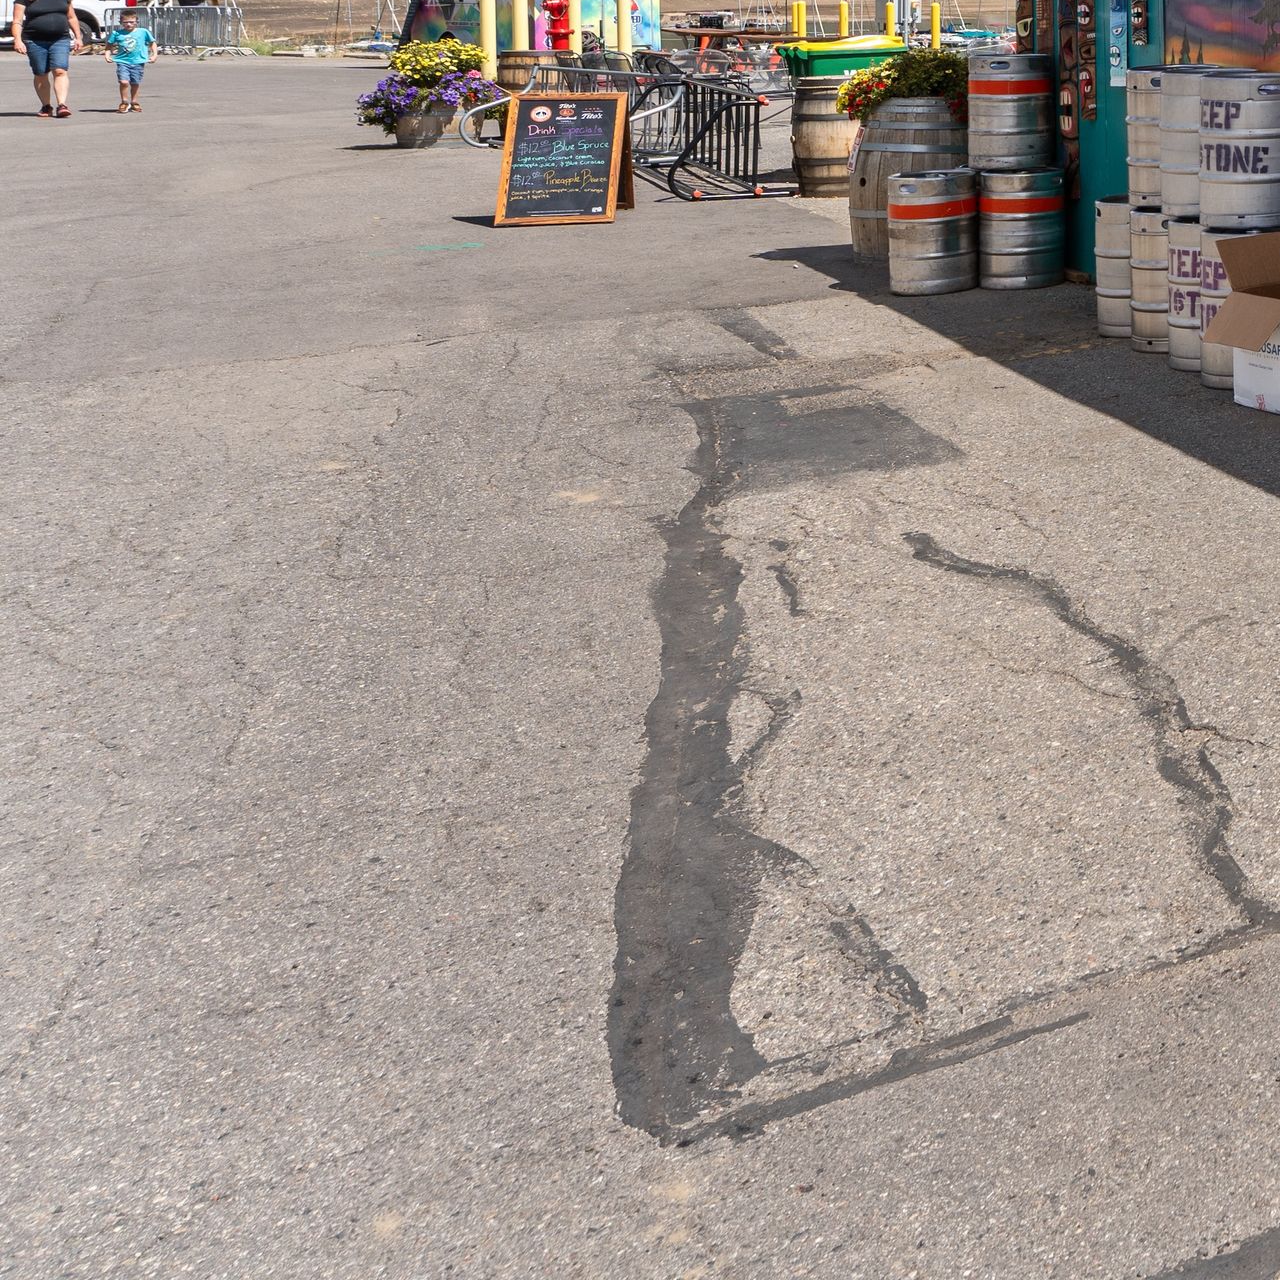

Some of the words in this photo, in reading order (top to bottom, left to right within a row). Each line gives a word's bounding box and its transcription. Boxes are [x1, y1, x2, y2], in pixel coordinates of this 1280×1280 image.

[528, 125, 556, 136] Drink
[550, 140, 575, 157] Blue
[578, 140, 609, 152] Spruce
[543, 170, 580, 186] Pineapple
